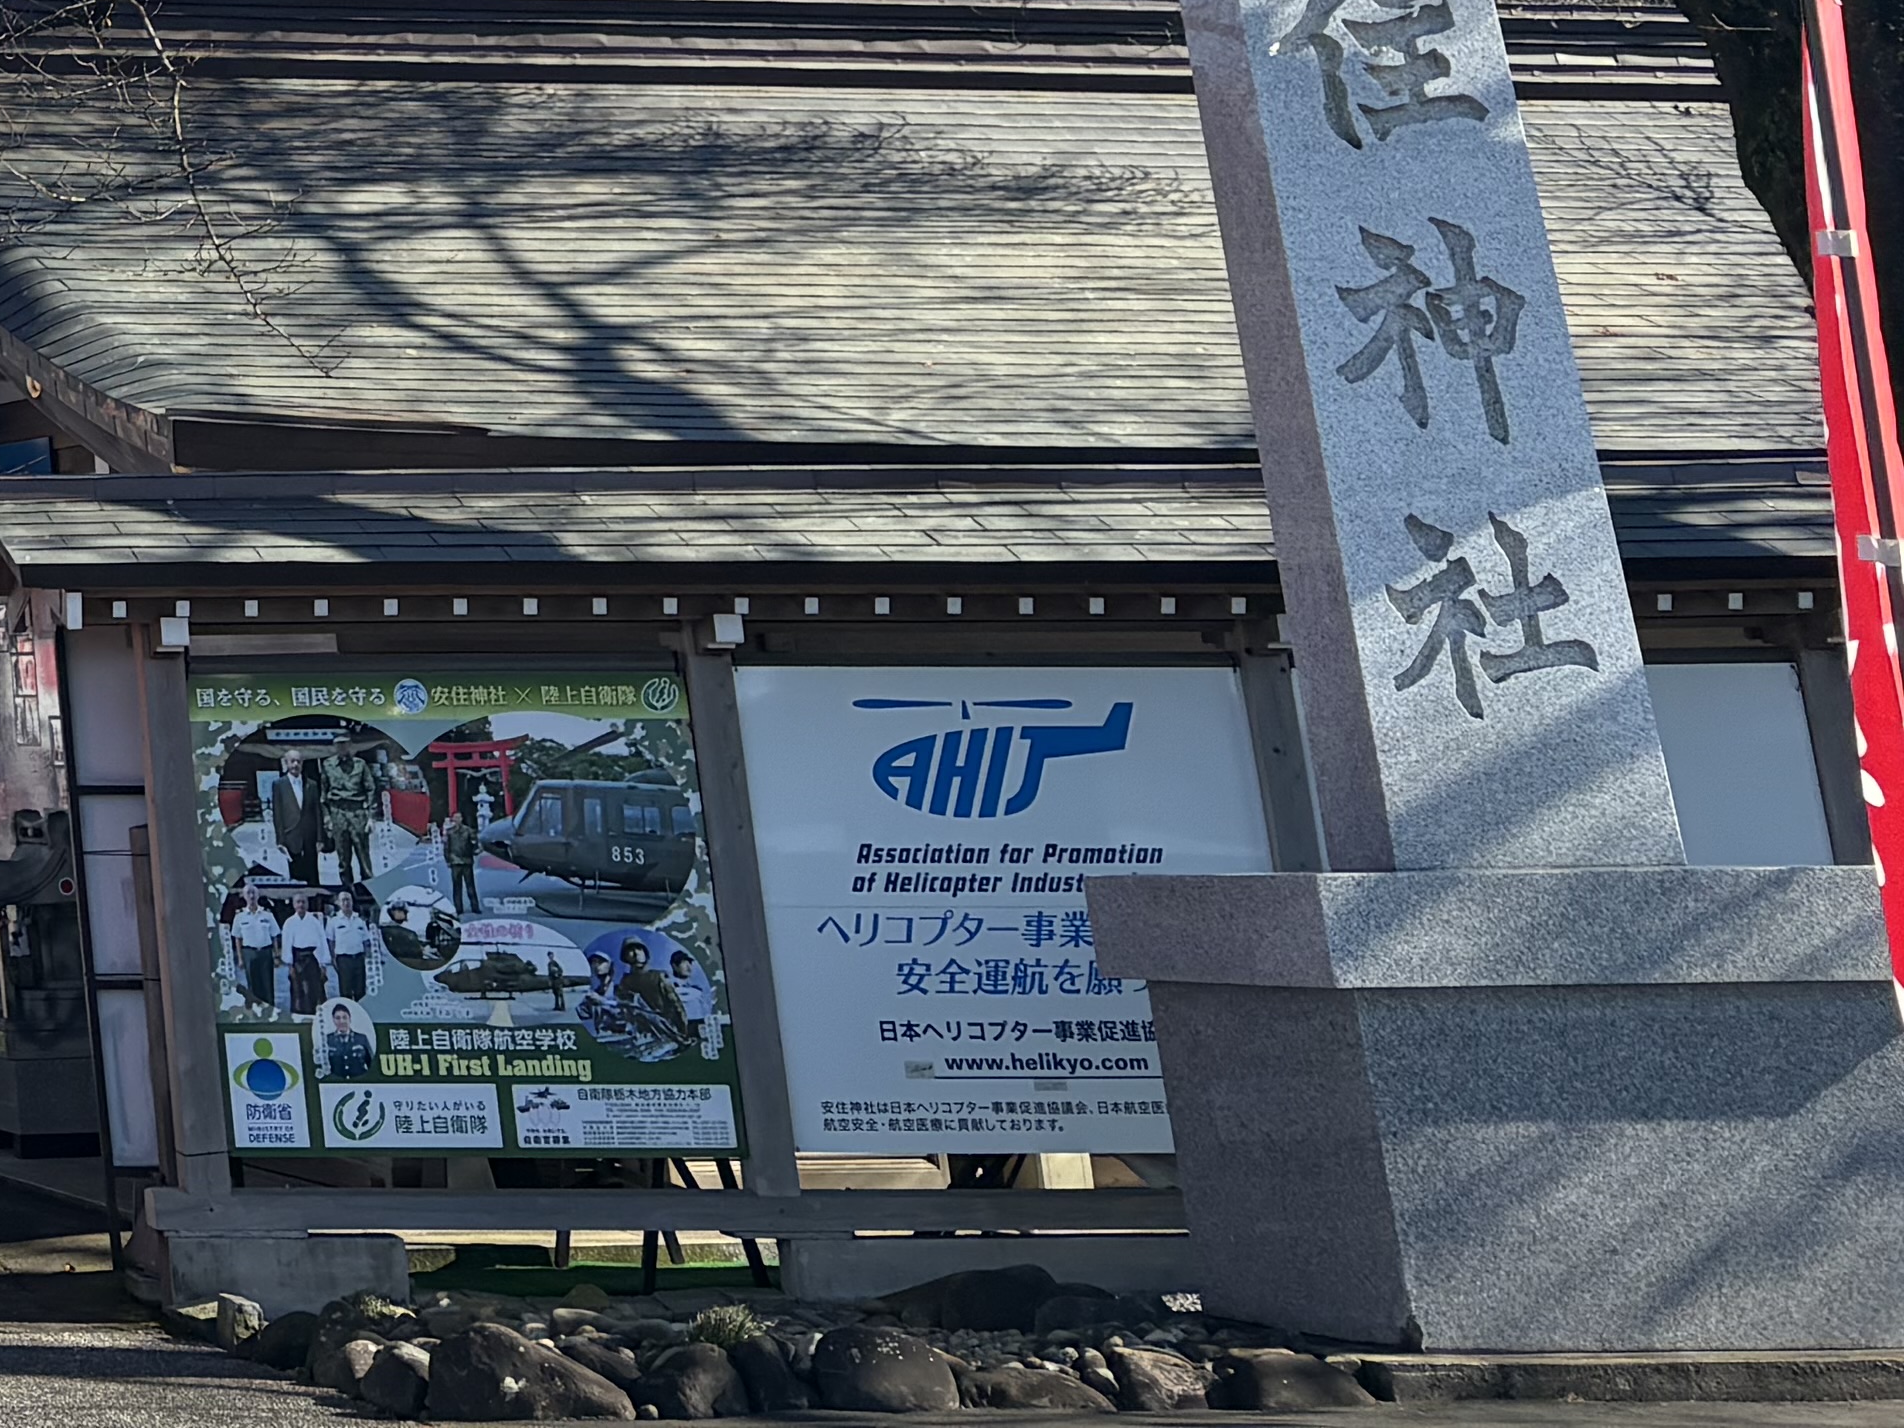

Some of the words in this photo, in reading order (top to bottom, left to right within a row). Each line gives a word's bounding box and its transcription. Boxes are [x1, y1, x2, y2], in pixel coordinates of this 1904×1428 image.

[196, 687, 281, 707] 国を守る、
[291, 686, 386, 707] 国民を守る
[430, 685, 508, 706] 安住神社
[540, 685, 638, 706] 陸上自衛隊
[612, 845, 646, 866] 853
[856, 843, 990, 865] Association
[999, 843, 1035, 865] for
[1041, 843, 1164, 865] Promotion
[851, 872, 880, 894] of
[884, 872, 1003, 898] Helicopter
[388, 1028, 578, 1050] 陸上自衛隊航空学校
[438, 1054, 491, 1077] First
[497, 1054, 592, 1081] Landing
[944, 1052, 1150, 1076] www.helikyo.com
[247, 1103, 293, 1122] 防衛省
[393, 1100, 487, 1112] 守りたい人がいる
[394, 1114, 489, 1135] 陸上自衛隊
[248, 1133, 296, 1144] DEFENSE
